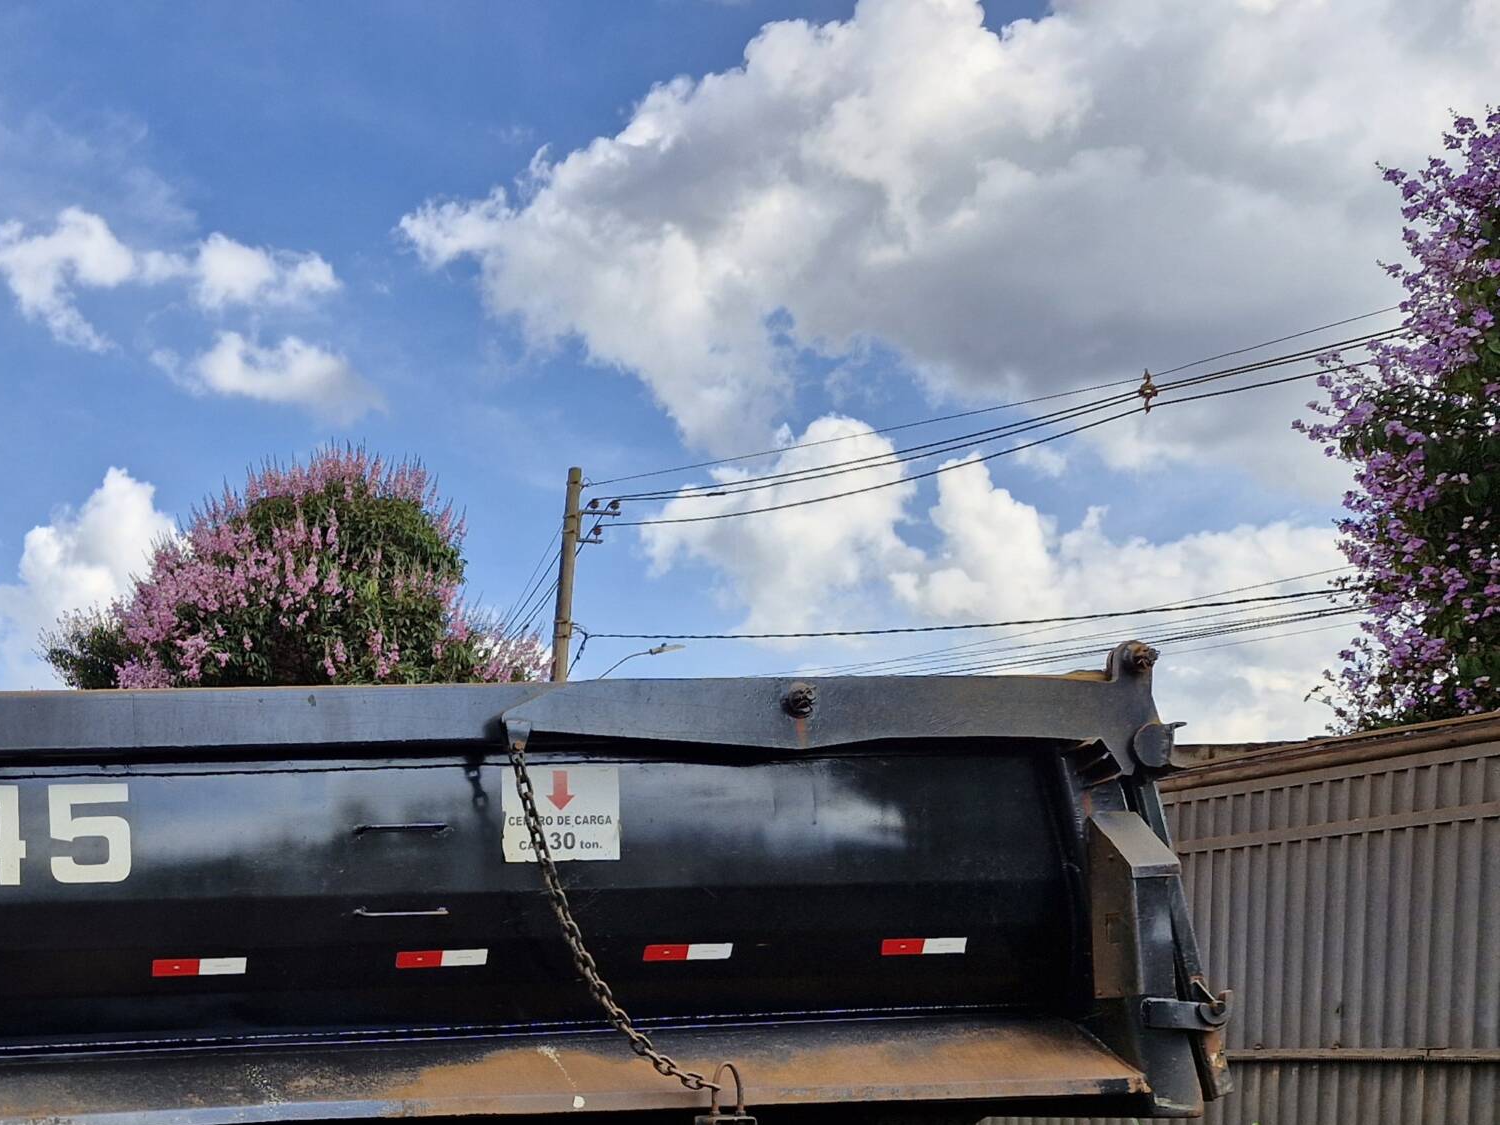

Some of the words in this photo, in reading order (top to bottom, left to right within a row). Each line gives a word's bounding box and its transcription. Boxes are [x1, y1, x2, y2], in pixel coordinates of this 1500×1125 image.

[508, 816, 553, 826] CERO
[557, 815, 570, 825] DE
[574, 815, 612, 825] CARGA
[550, 832, 576, 850] 30
[580, 840, 602, 850] ton.
